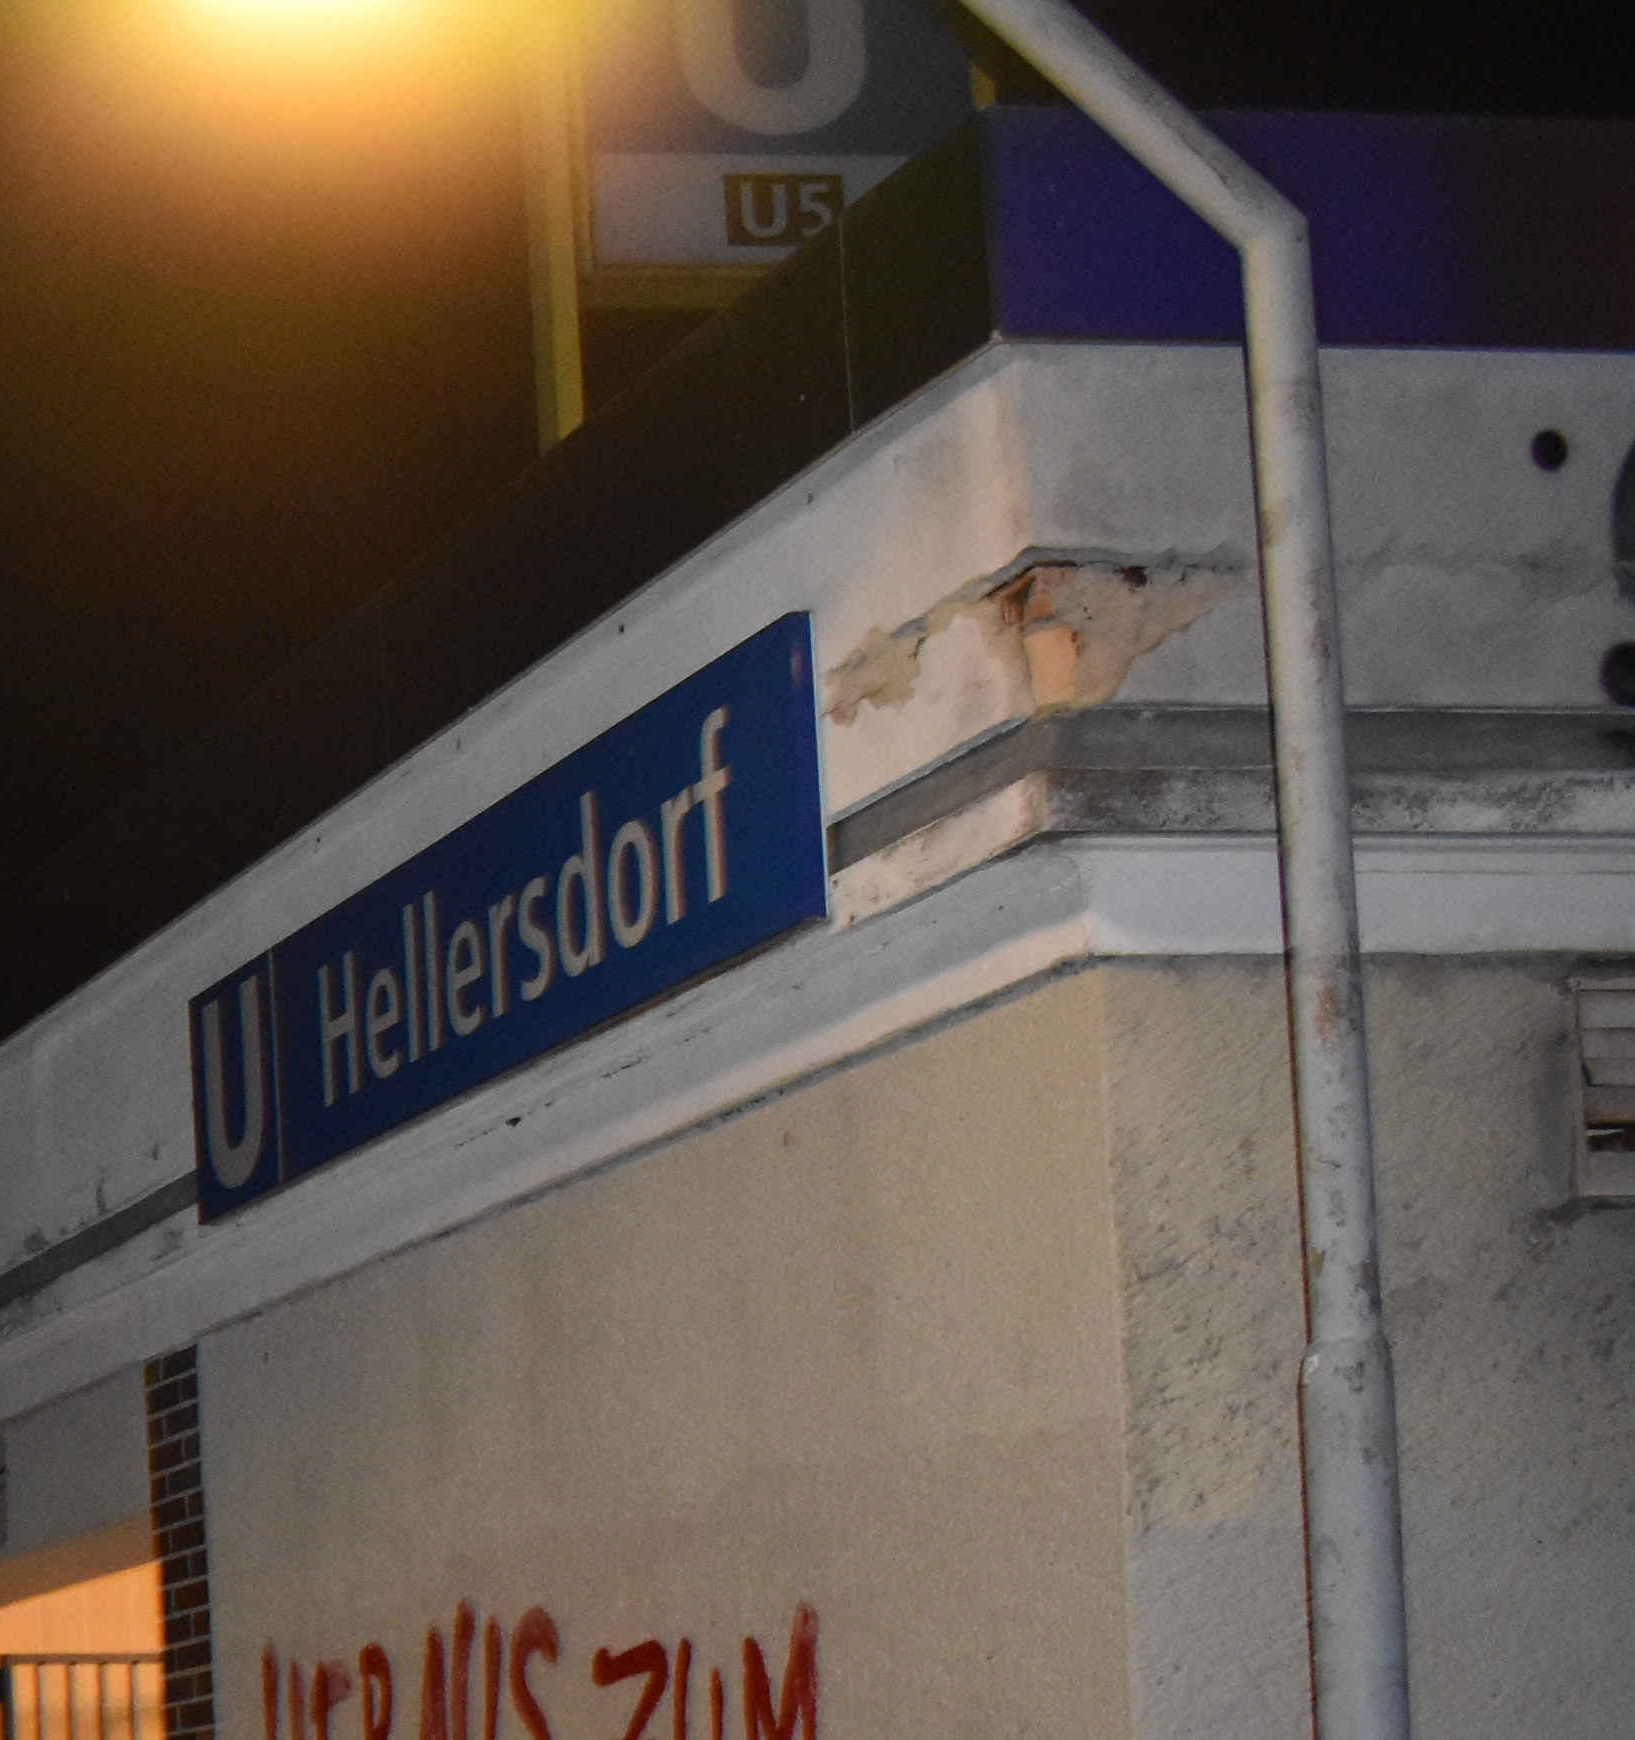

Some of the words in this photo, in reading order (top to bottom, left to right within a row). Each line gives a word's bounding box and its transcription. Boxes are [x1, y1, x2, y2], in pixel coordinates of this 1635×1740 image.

[741, 181, 832, 237] U5
[201, 976, 266, 1188] U
[317, 706, 731, 1108] Hellersdorf
